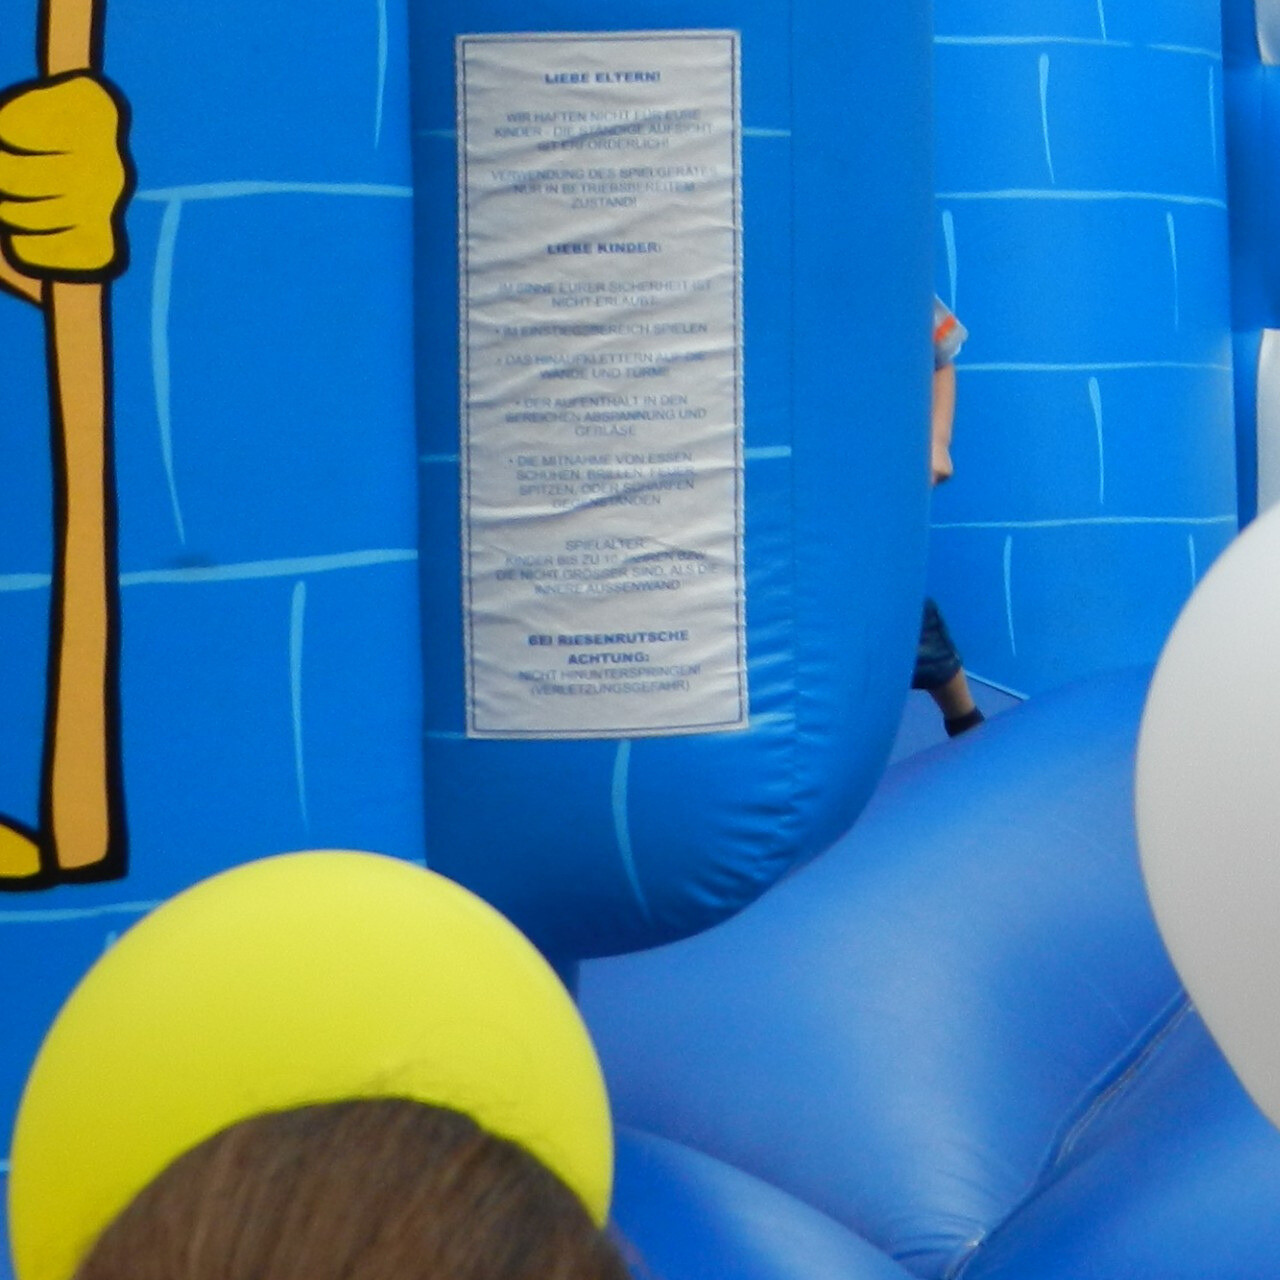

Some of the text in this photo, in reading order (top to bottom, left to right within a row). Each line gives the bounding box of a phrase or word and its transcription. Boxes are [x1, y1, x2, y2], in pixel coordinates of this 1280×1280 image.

[545, 71, 661, 84] LIEBE ELTERN!
[507, 112, 530, 122] WIR
[534, 111, 586, 122] HAFTEN
[588, 169, 616, 180] DES
[547, 243, 592, 255] LIEBE
[608, 280, 688, 292] SICHERHEIT
[654, 322, 708, 334] SPIELEN
[592, 368, 621, 379] UND
[660, 394, 688, 406] DEN
[678, 408, 707, 420] UND
[517, 456, 536, 467] DIE
[616, 453, 645, 465] VON
[528, 630, 690, 646] BEI RIESENRUTSCHE
[567, 651, 650, 665] ACHTUNG:
[518, 671, 557, 682] NICHT
